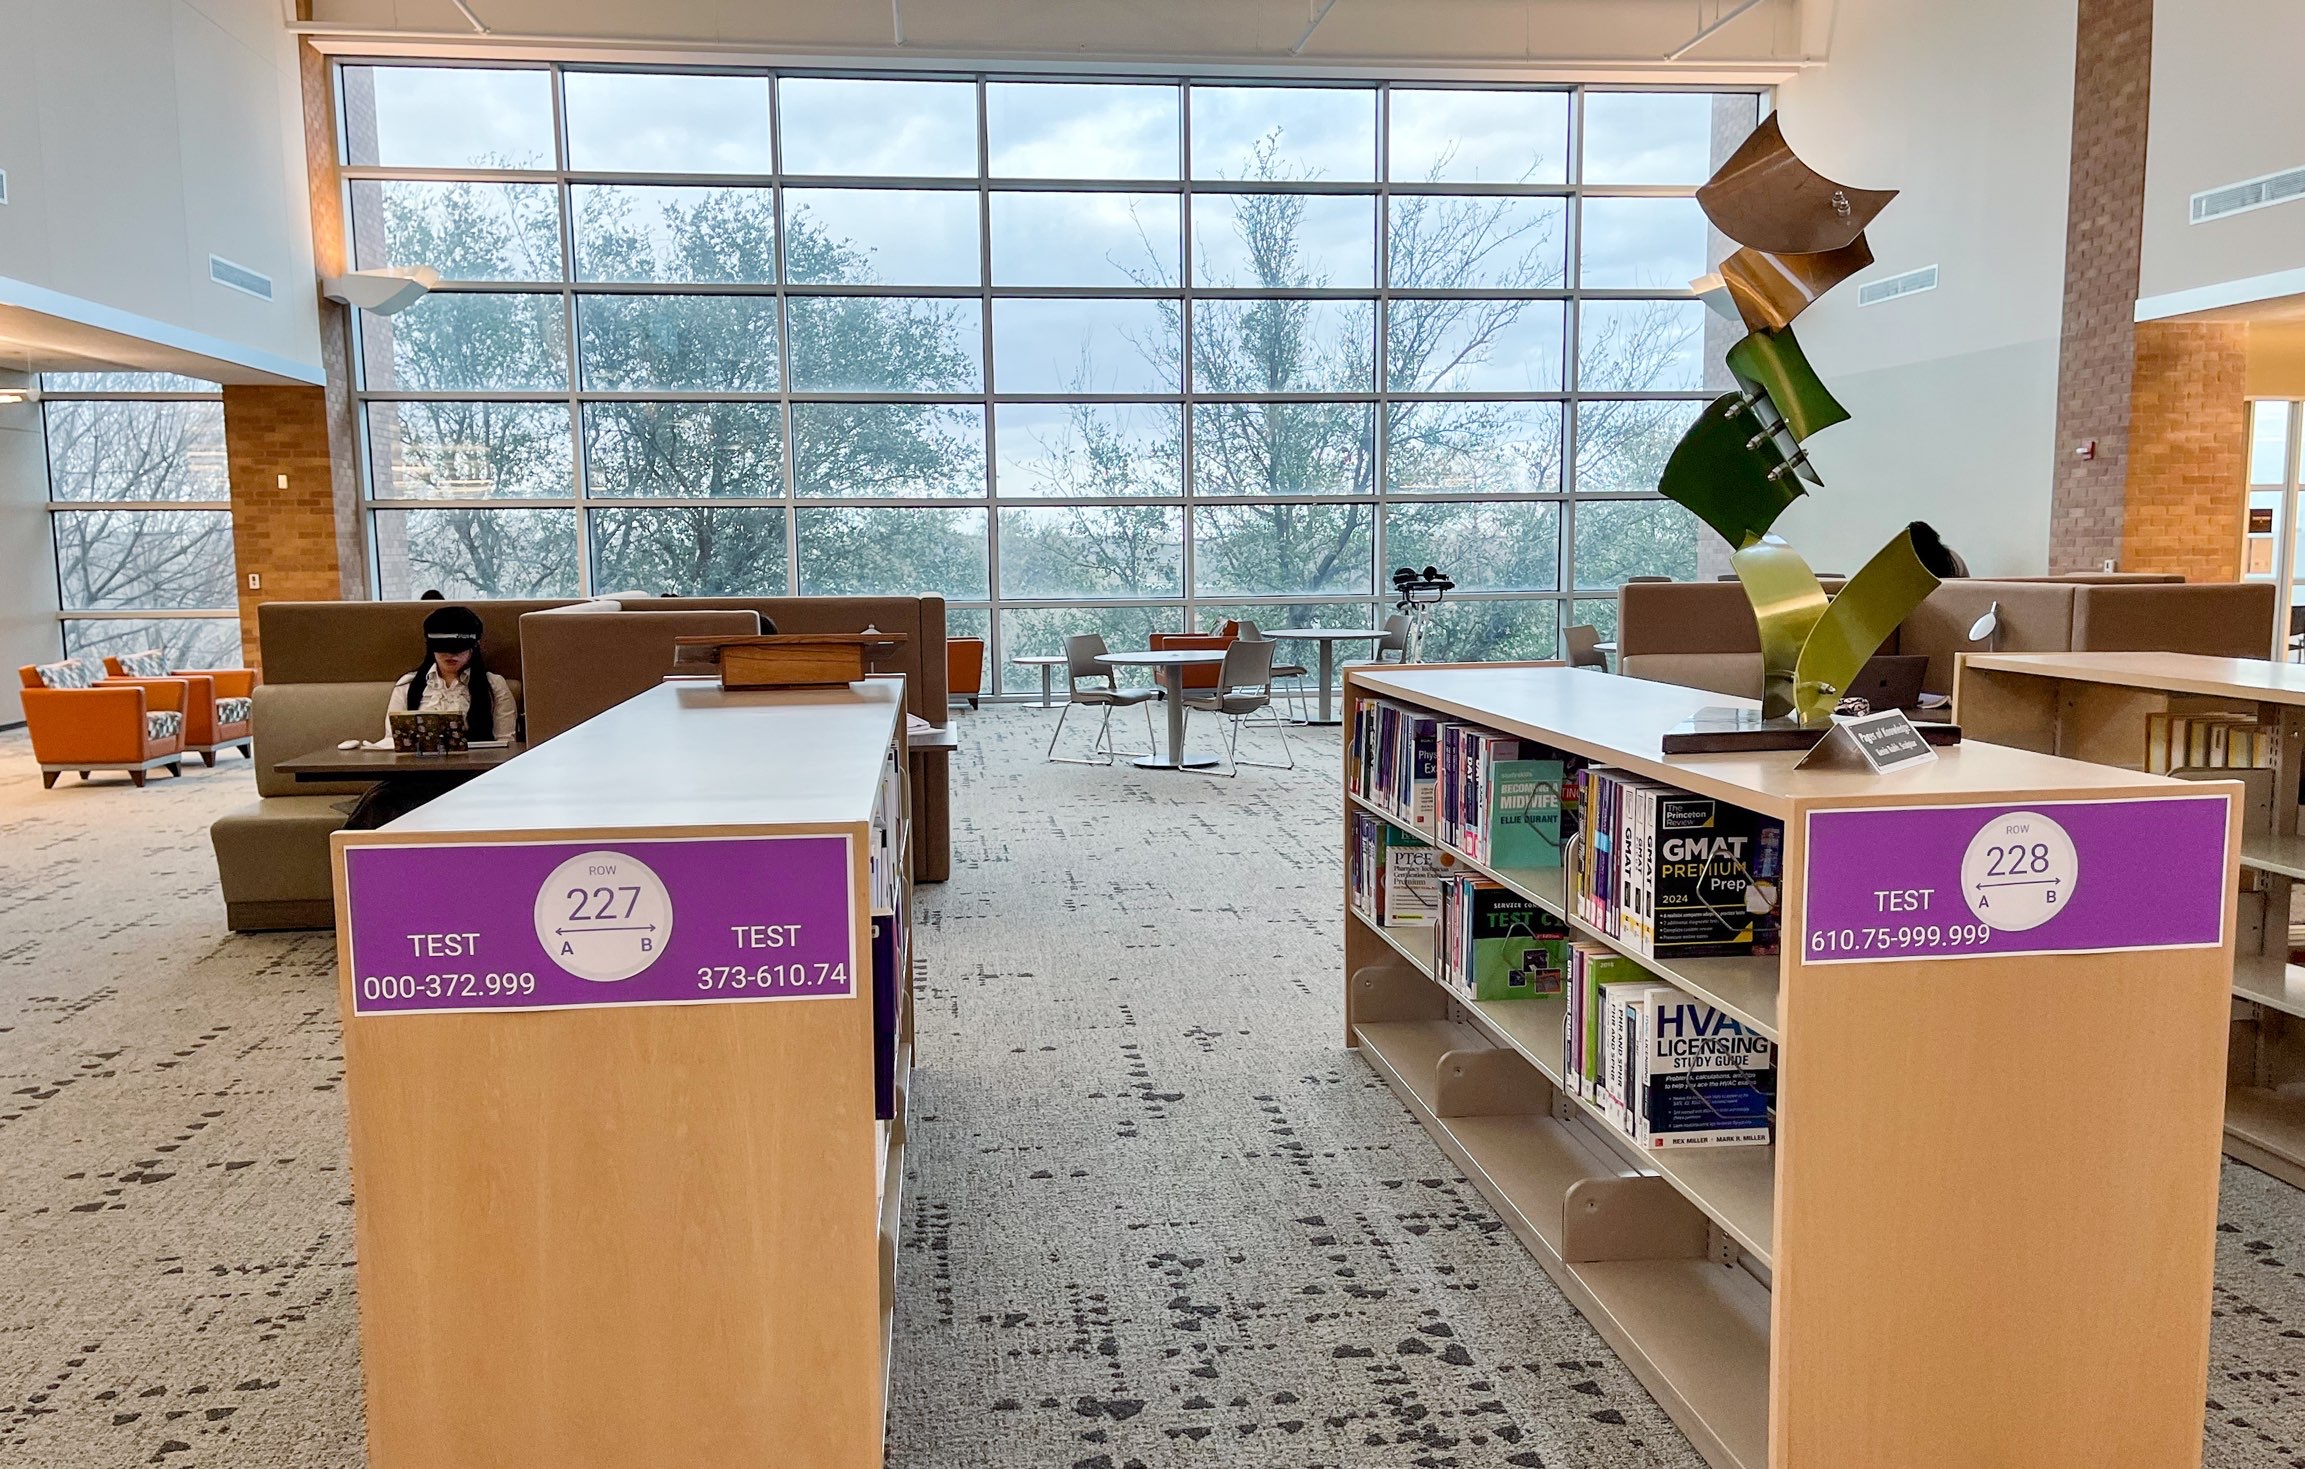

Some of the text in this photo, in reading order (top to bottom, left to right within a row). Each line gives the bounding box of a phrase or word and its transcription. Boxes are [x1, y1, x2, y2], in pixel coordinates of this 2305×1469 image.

[1501, 783, 1559, 794] BECOMING A
[1500, 794, 1559, 809] MIDWIFE
[1667, 804, 1683, 812] The
[1500, 815, 1559, 825] ELLIE DURANT
[1666, 811, 1707, 819] Princeton
[1666, 819, 1695, 827] Review
[2006, 824, 2031, 835] ROW
[1624, 827, 1632, 878] GMAT
[1636, 838, 1644, 877] GMAT
[1662, 836, 1748, 862] GMAT
[1645, 835, 1654, 887] GMAT
[1986, 843, 2050, 877] 228
[589, 865, 617, 876] ROW
[1662, 862, 1747, 878] PREMIUM
[1711, 878, 1746, 892] Prep
[567, 886, 642, 921] 227
[1524, 901, 1541, 909] CON
[1662, 894, 1688, 904] 2024
[1874, 888, 1935, 913] TEST
[1978, 890, 2056, 909] A B
[1486, 912, 1533, 928] TEST
[731, 924, 802, 949] TEST
[1810, 924, 1991, 952] 610.75-999.999
[407, 933, 480, 958] TEST
[560, 937, 653, 956] A B
[697, 963, 847, 991] 373-610.74
[363, 972, 535, 1000] 000-372.999
[1657, 1036, 1768, 1057] LICENSING
[1674, 1055, 1749, 1068] STUDY GUIDE
[1742, 1134, 1766, 1142] MILLER
